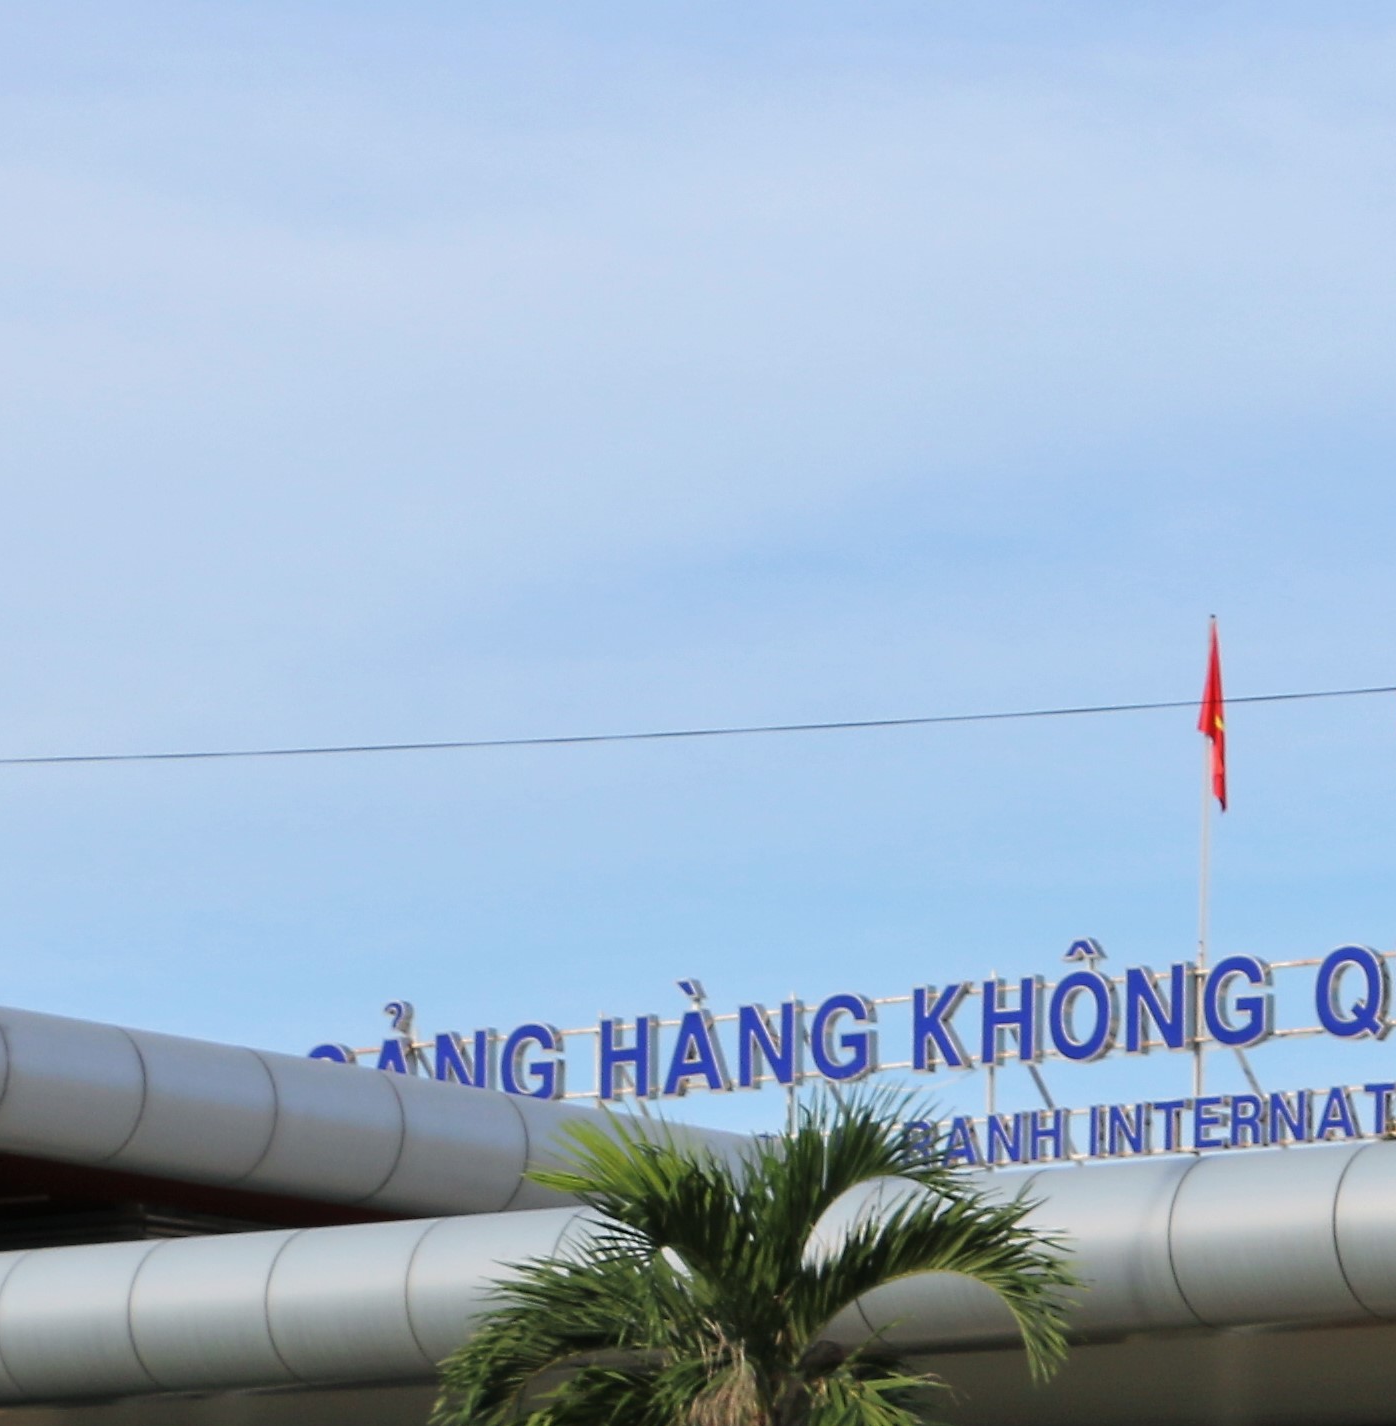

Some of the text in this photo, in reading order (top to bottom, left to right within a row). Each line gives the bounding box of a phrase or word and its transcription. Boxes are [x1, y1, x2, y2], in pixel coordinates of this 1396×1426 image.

[308, 1000, 566, 1101] ẢNG
[598, 978, 877, 1099] HÀNG
[911, 937, 1273, 1074] KHÔNG
